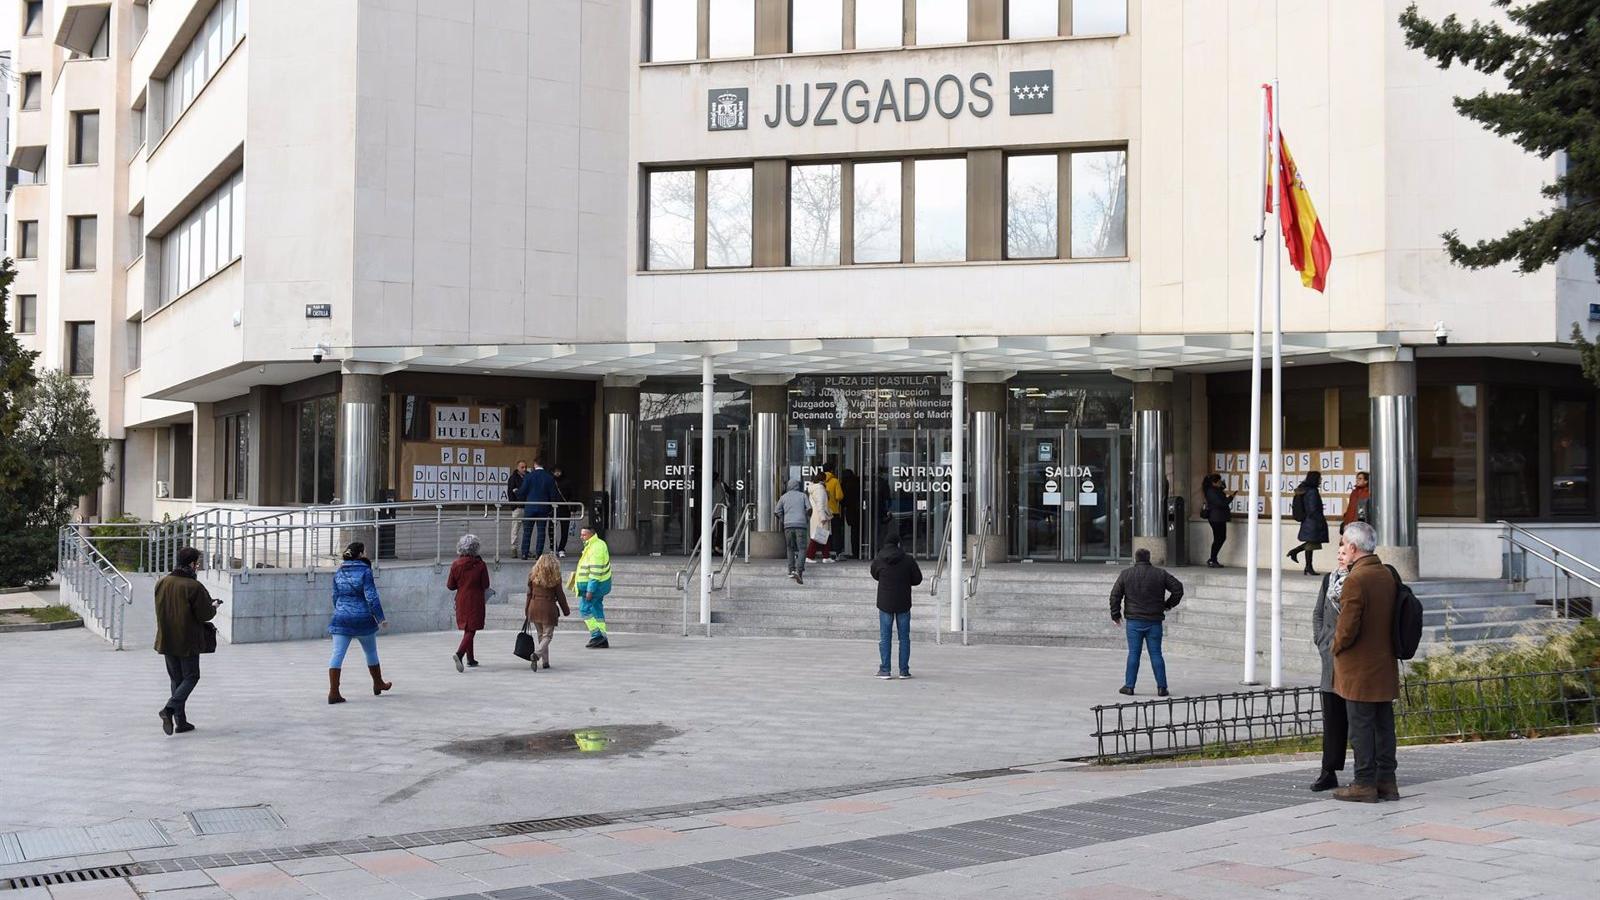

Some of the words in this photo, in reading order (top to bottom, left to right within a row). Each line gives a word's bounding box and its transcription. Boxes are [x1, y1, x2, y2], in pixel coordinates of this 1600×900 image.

[764, 72, 994, 128] JUZGADOS
[825, 377, 858, 385] PLAZA
[861, 377, 874, 385] DE
[879, 376, 929, 385] CASTILLA
[792, 400, 835, 409] Juzgados
[438, 411, 466, 422] LAJ
[481, 412, 500, 423] EN
[792, 411, 834, 419] Decanato
[848, 411, 862, 419] los
[864, 411, 911, 420] Juzgados
[914, 410, 925, 418] de
[927, 410, 953, 418] Madri
[438, 427, 500, 438] HUELGA
[443, 453, 482, 463] POR
[1322, 457, 1340, 469] DE
[415, 470, 509, 481] DIGNIDAD
[892, 466, 953, 477] ENTRADA
[1045, 466, 1092, 478] SALIDA
[894, 479, 951, 492] PÚBLICO
[414, 488, 508, 500] JUSTICIA
